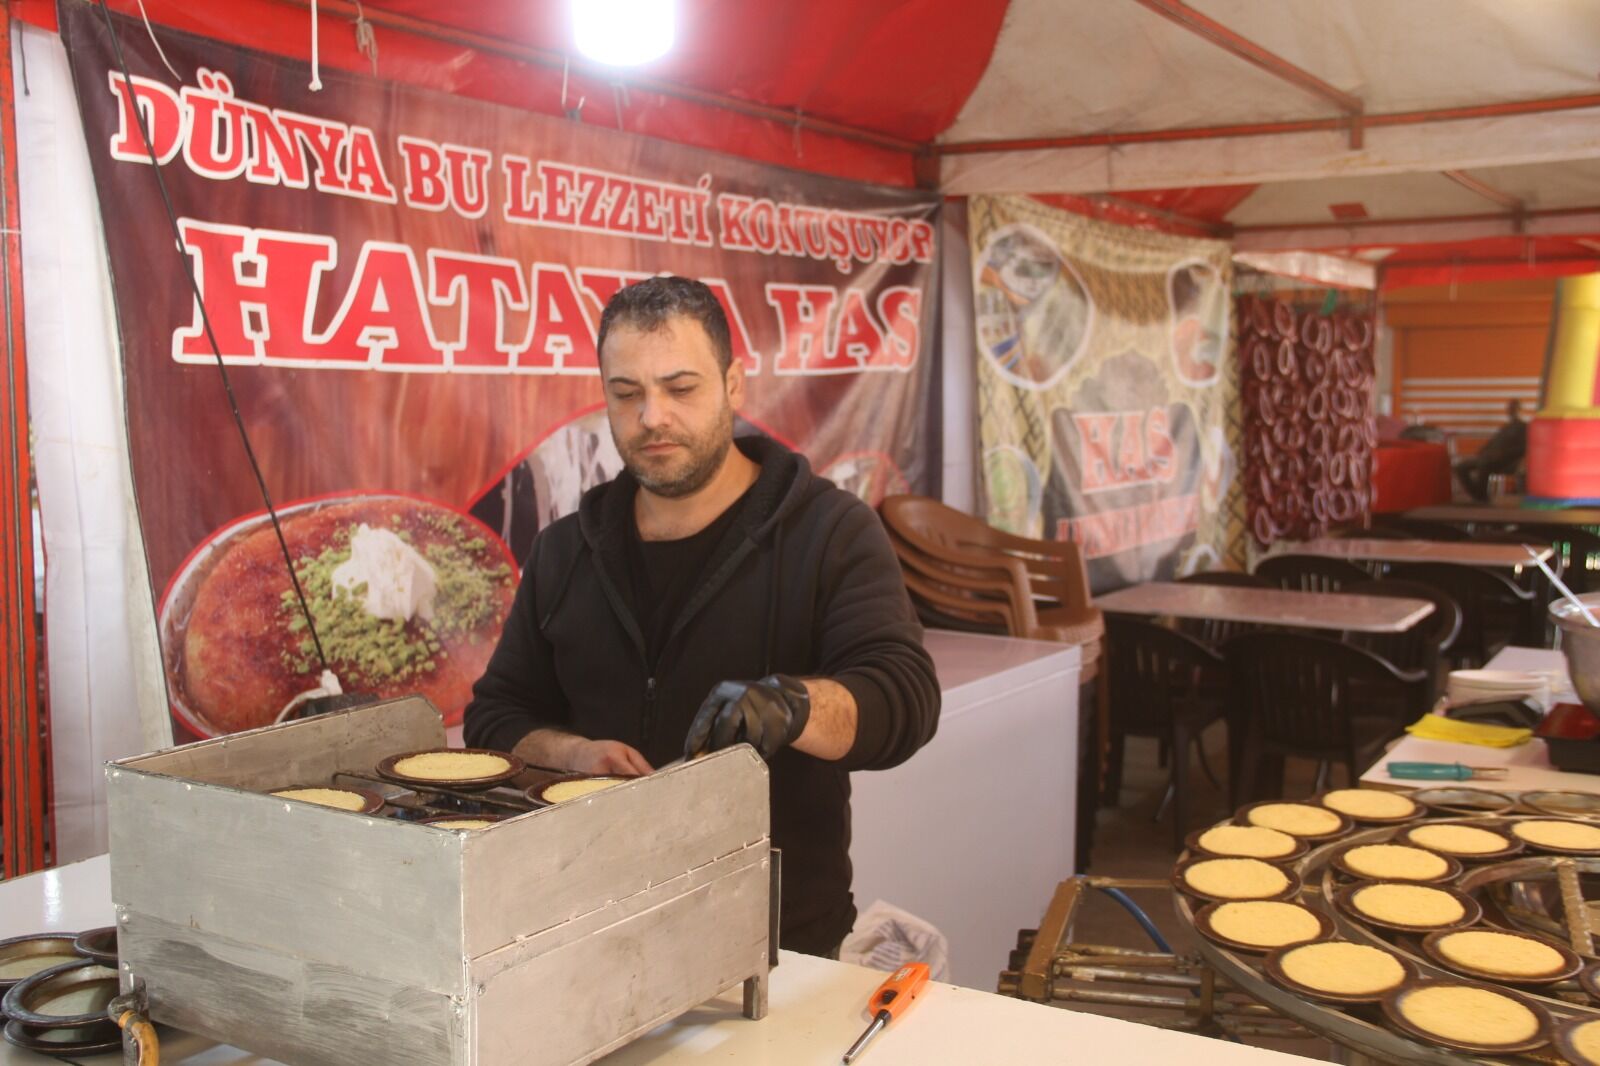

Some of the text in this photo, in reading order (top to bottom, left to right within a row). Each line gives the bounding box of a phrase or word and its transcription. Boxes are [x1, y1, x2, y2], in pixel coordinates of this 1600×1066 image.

[109, 68, 936, 275] DÜNYA BU LEZZETİ KONUŞUYOR
[765, 282, 923, 376] HAS
